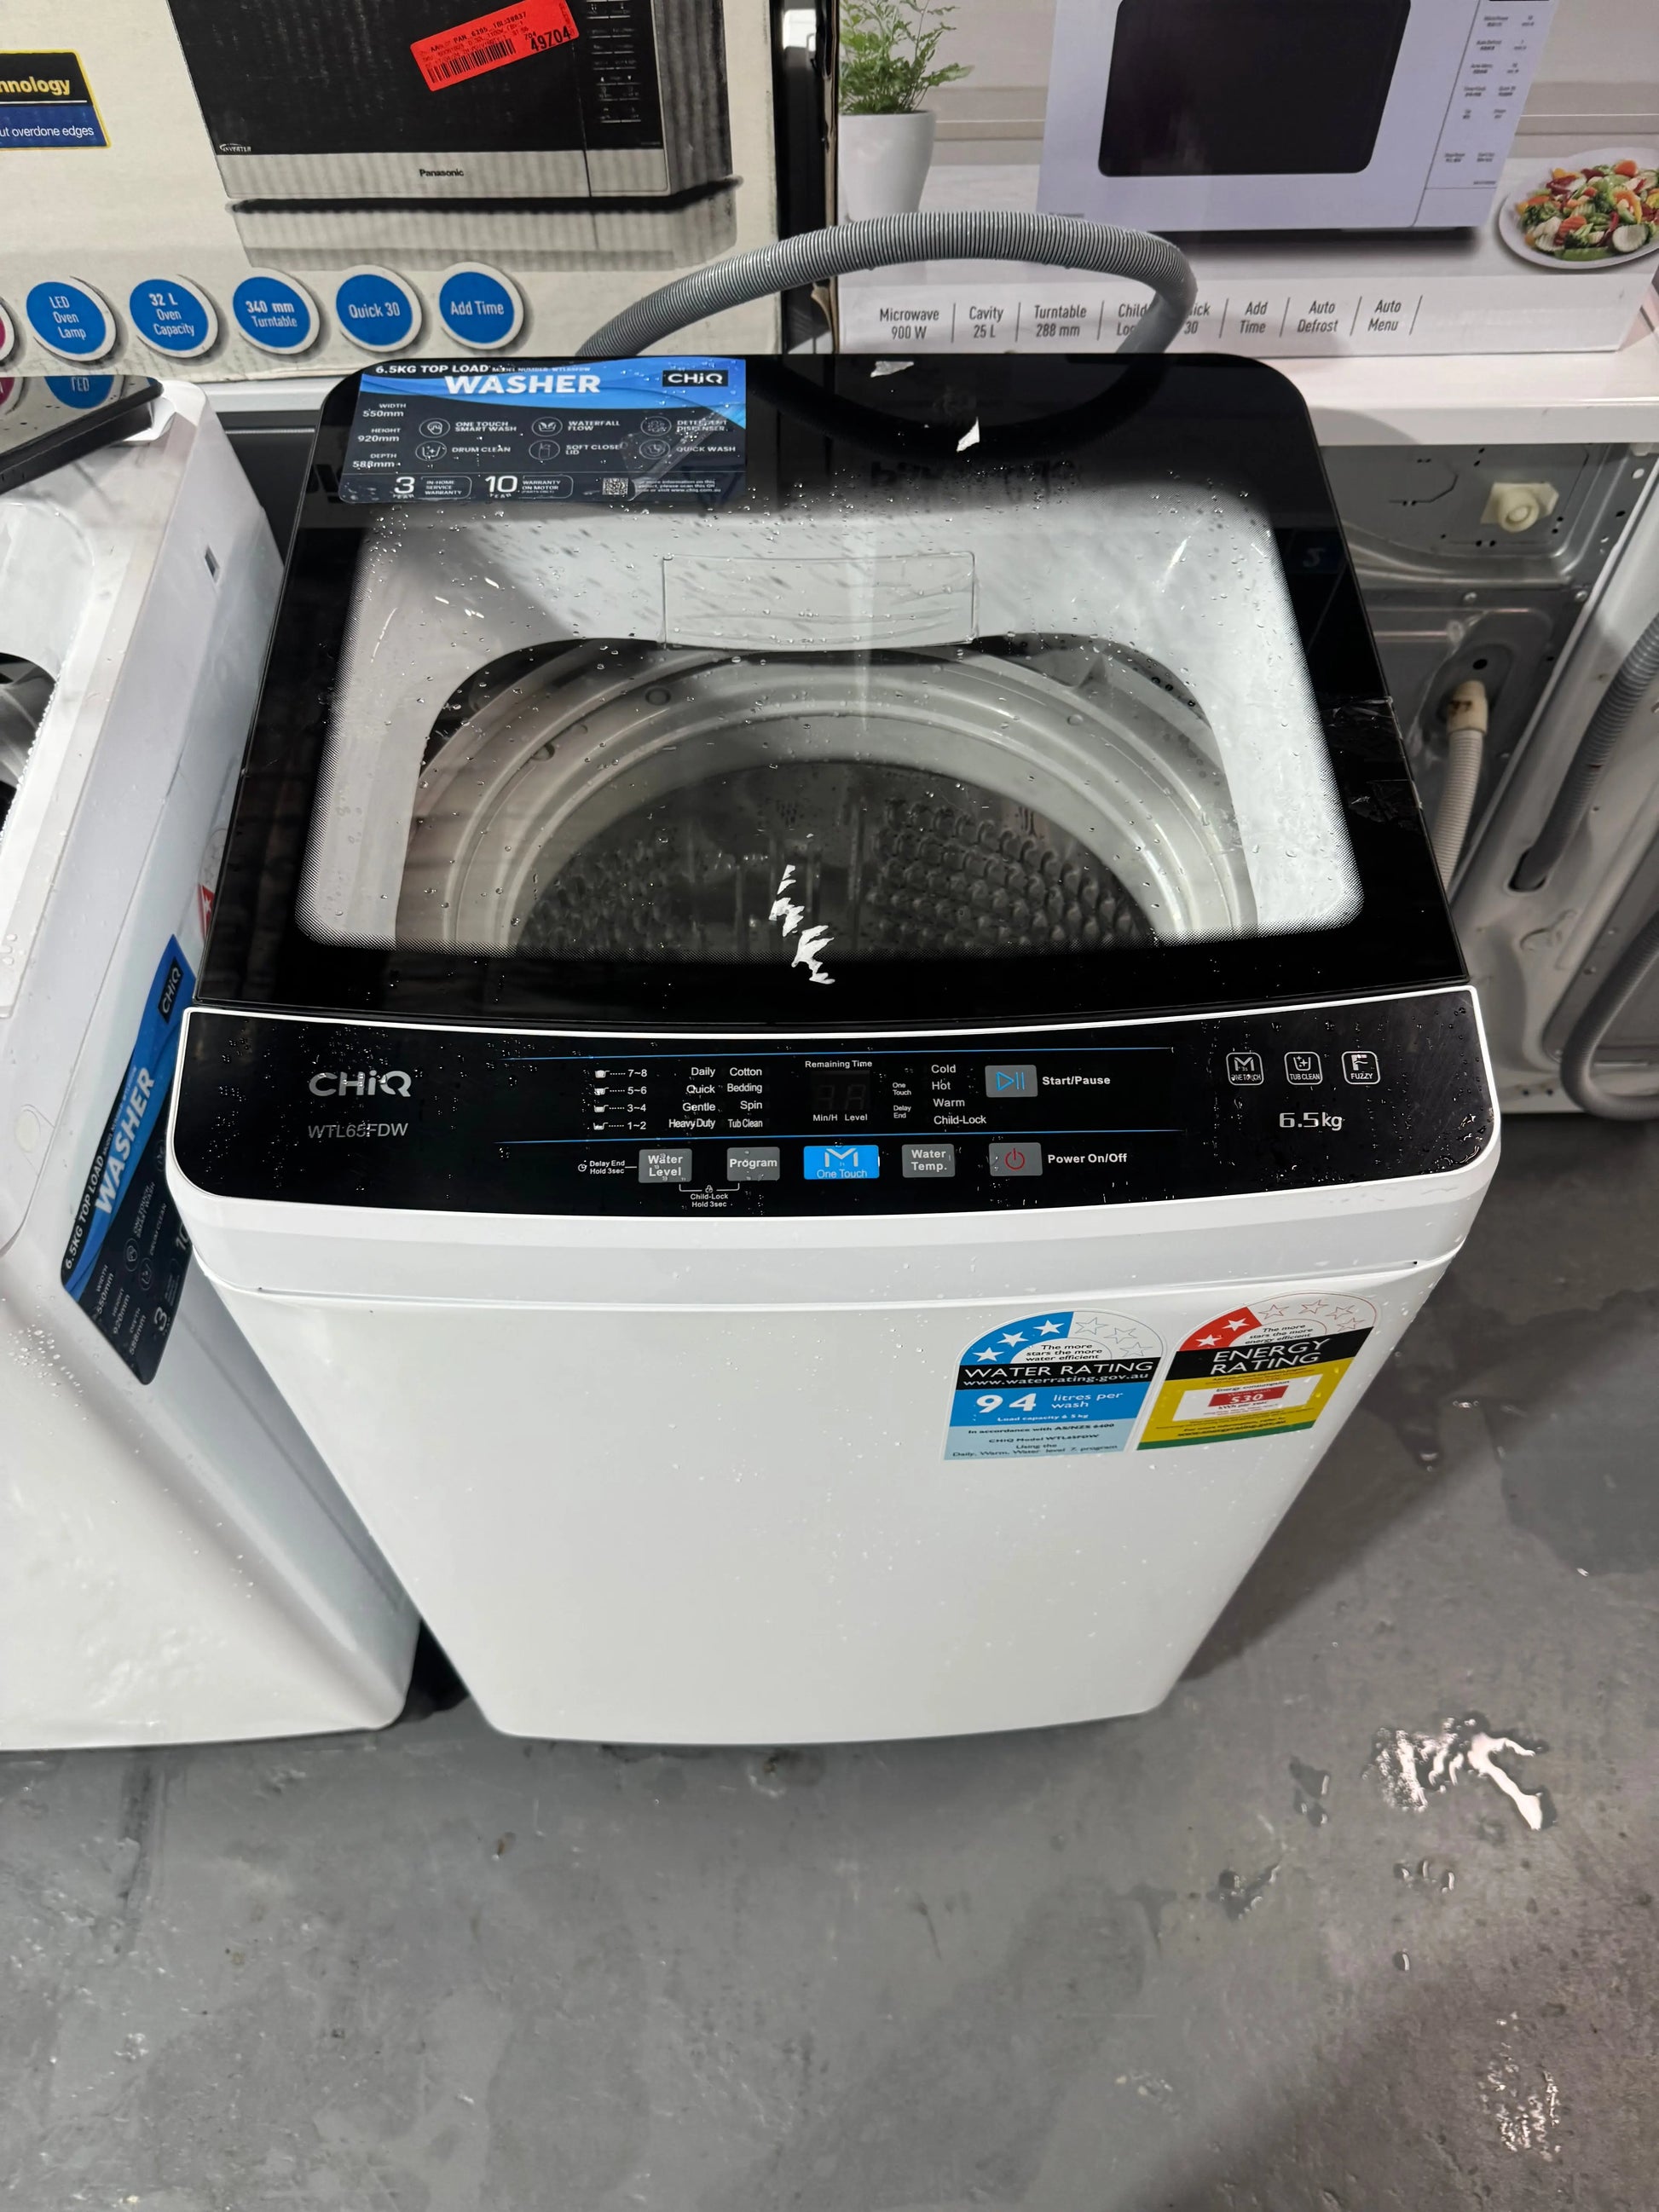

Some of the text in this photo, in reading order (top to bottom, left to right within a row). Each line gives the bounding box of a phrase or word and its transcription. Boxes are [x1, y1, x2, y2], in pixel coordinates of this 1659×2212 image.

[12, 124, 95, 139] overdone edges
[419, 169, 465, 177] Panasonic
[49, 296, 70, 309] LED
[149, 292, 178, 307] 32 L
[246, 301, 295, 314] 340 mm
[349, 302, 401, 320] Quick 30
[450, 300, 505, 315] Add Time
[1034, 304, 1087, 319] Turntable
[1245, 302, 1268, 315] Add
[1309, 300, 1335, 315] Auto
[1375, 299, 1402, 314] Auto
[53, 310, 79, 324] Oven
[156, 309, 182, 321] Oven
[879, 307, 939, 321] Microwave
[969, 305, 1003, 323] Cavity
[252, 315, 298, 328] Turntable
[1184, 321, 1199, 335] 30
[1240, 321, 1266, 335] Time
[1298, 319, 1338, 333] Defrost
[1368, 318, 1399, 332] Menu
[58, 326, 87, 341] Lamp
[153, 323, 195, 338] Capacity
[892, 326, 928, 339] 900 W
[974, 325, 997, 338] 25 L
[1037, 323, 1081, 338] 288 mm
[375, 364, 489, 373] 6.5KG TOP LOAD
[444, 375, 601, 394] WASHER
[363, 409, 404, 418] 550mm
[352, 459, 396, 468] 588mm
[394, 476, 415, 494] 3
[485, 475, 518, 493] 10
[806, 1060, 851, 1070] Remaining
[931, 1064, 957, 1074] Cold
[691, 1066, 716, 1078] Daily
[729, 1067, 763, 1077] Cotton
[1350, 1072, 1373, 1081] FUZZY
[931, 1081, 951, 1090] Hot
[1042, 1076, 1112, 1086] Start/Pause
[686, 1084, 716, 1094] Quick
[727, 1083, 763, 1094] Bedding
[682, 1102, 716, 1112] Gentle
[740, 1100, 763, 1111] Spin
[933, 1098, 966, 1107] Warm
[668, 1118, 716, 1129] Heavy Duty
[728, 1118, 763, 1129] Tub Clean
[812, 1112, 868, 1122] Min/H Level
[933, 1115, 987, 1125] Child-Lock
[1280, 1112, 1344, 1131] 6.5kg
[95, 1066, 155, 1215] WASHER
[648, 1154, 684, 1164] Water
[911, 1149, 947, 1159] Water
[1048, 1153, 1128, 1164] Power On/Off
[589, 1160, 610, 1169] Delay
[729, 1158, 778, 1169] Program
[910, 1161, 948, 1172] Temp.
[649, 1166, 682, 1177] Level
[817, 1169, 868, 1179] One Touch
[691, 1192, 729, 1200] Child-Lock
[691, 1200, 709, 1209] Hold
[65, 1155, 104, 1270] 6.5KG TOP LOAD
[96, 1272, 114, 1315] 550mm
[113, 1294, 131, 1336] 920mm
[153, 1306, 168, 1332] 3
[129, 1314, 147, 1355] 588mm
[1214, 1338, 1331, 1363] ENERGY
[963, 1361, 1154, 1378] WATER RATING
[1211, 1353, 1321, 1376] RATING
[962, 1373, 1149, 1387] www.waterrating.gov.au
[975, 1393, 1038, 1413] 94
[1053, 1391, 1124, 1402] litres per
[1229, 1394, 1264, 1404] 530
[1051, 1401, 1089, 1409] wash
